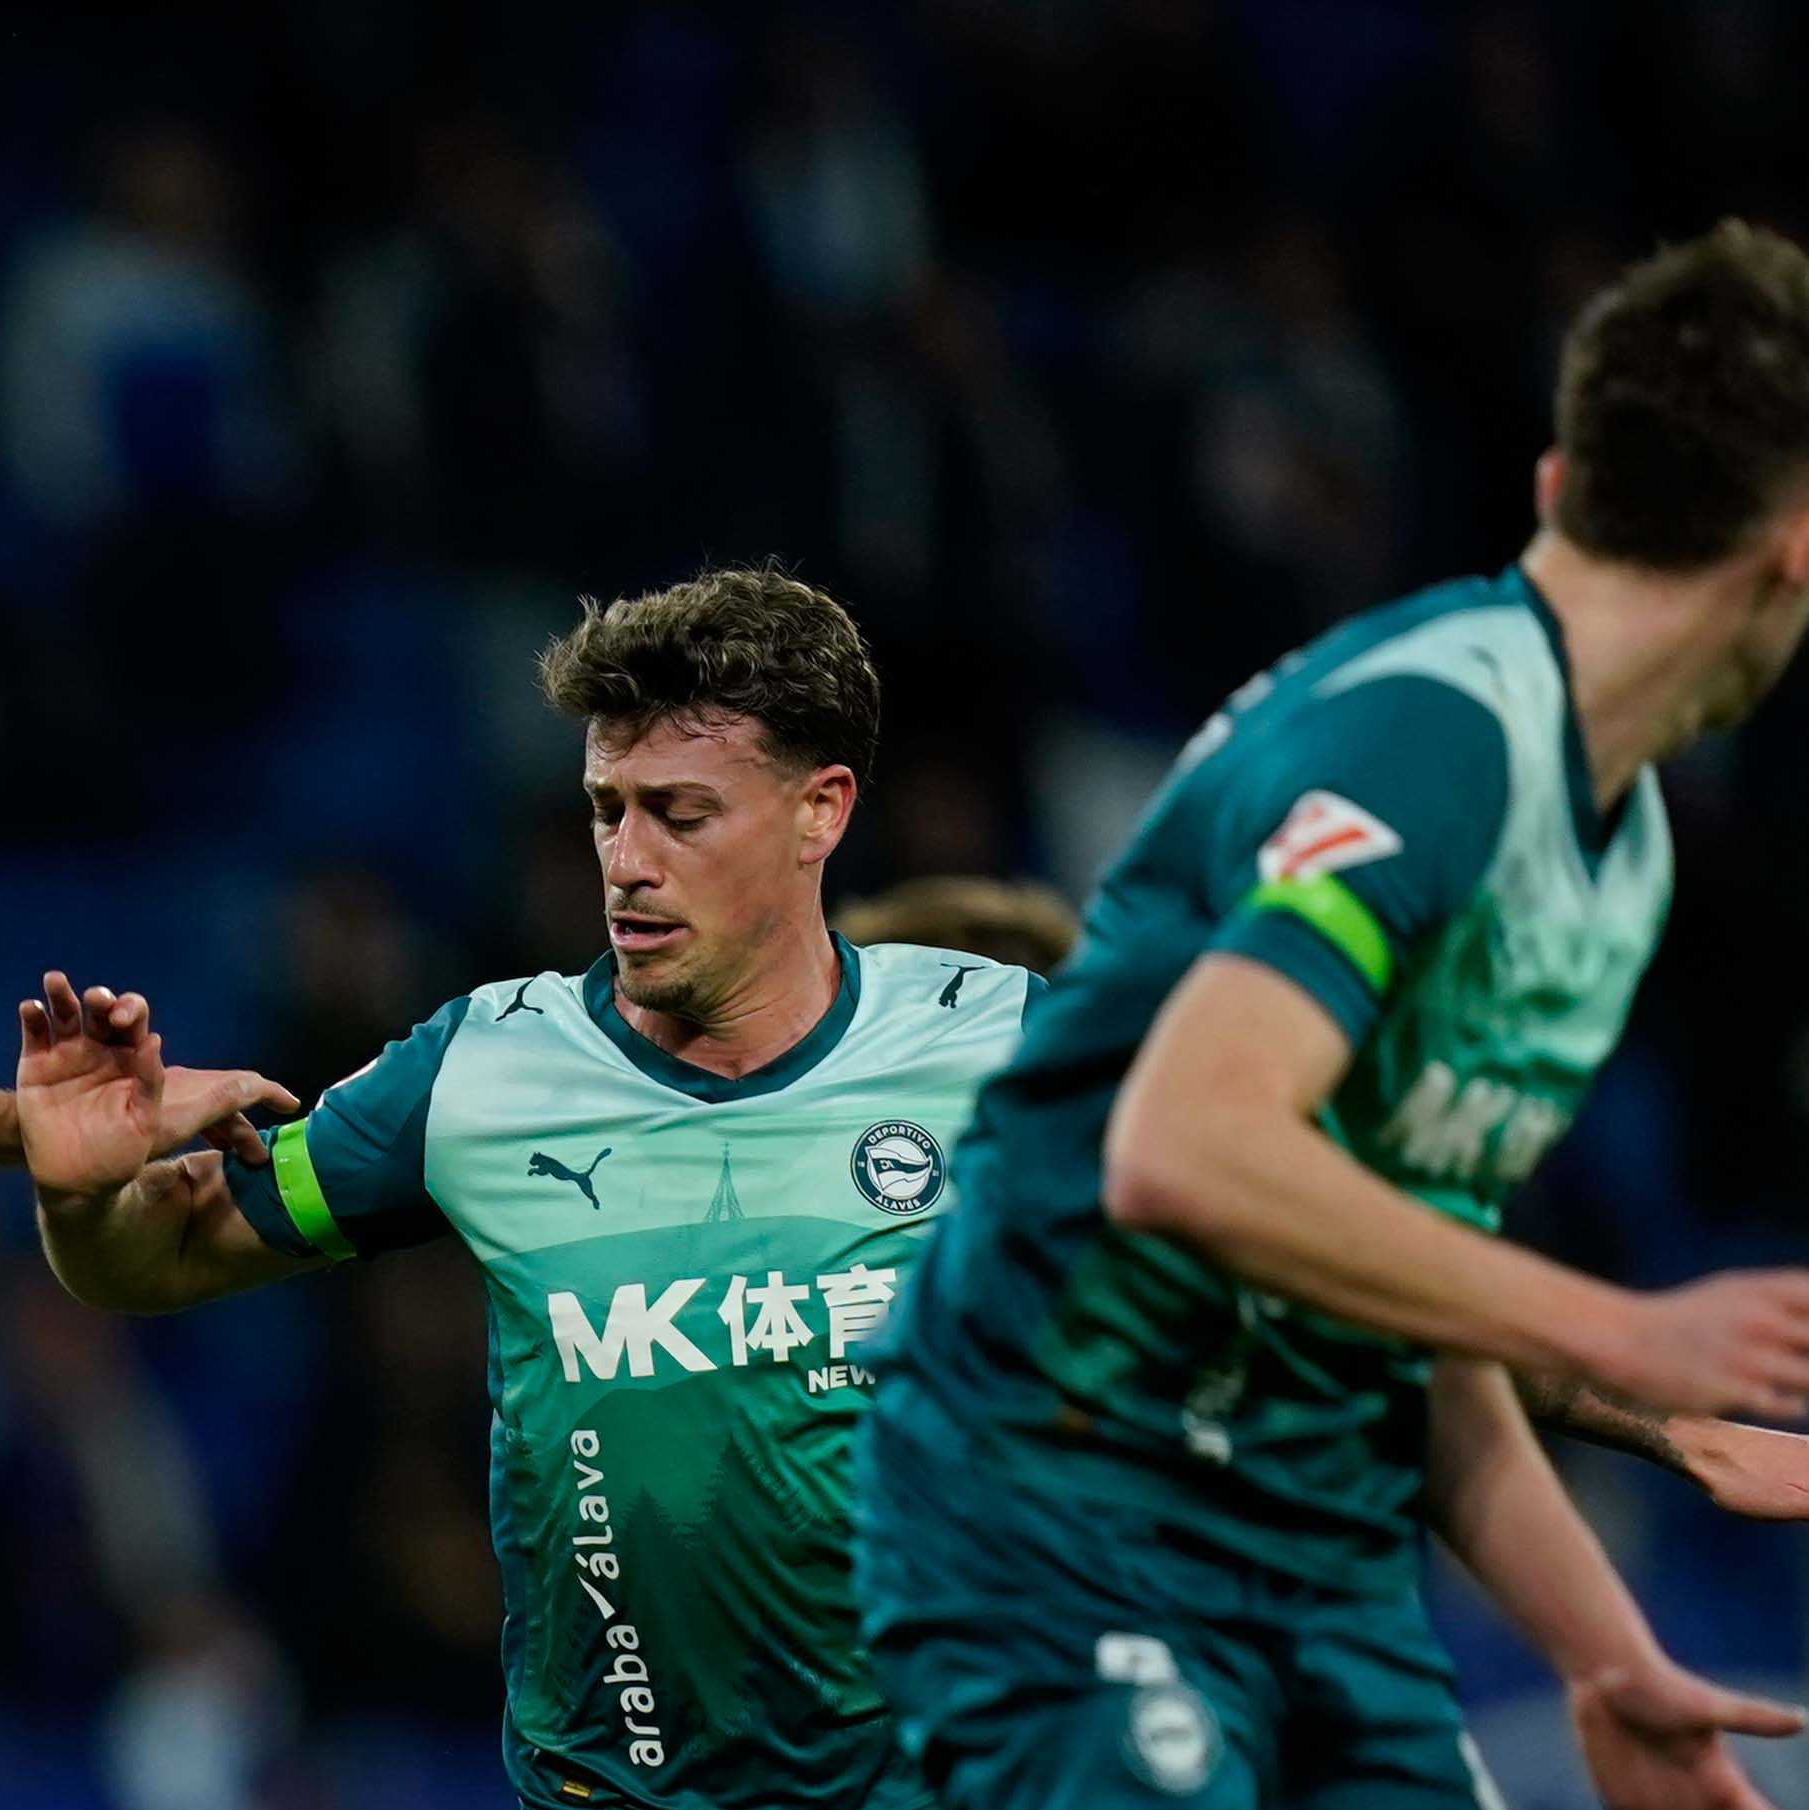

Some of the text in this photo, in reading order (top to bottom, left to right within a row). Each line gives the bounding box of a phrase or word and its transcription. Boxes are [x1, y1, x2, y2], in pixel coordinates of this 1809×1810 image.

[867, 1124, 932, 1150] DEPORTIVO
[807, 1364, 877, 1394] NEW
[569, 1428, 666, 1768] araba álava
